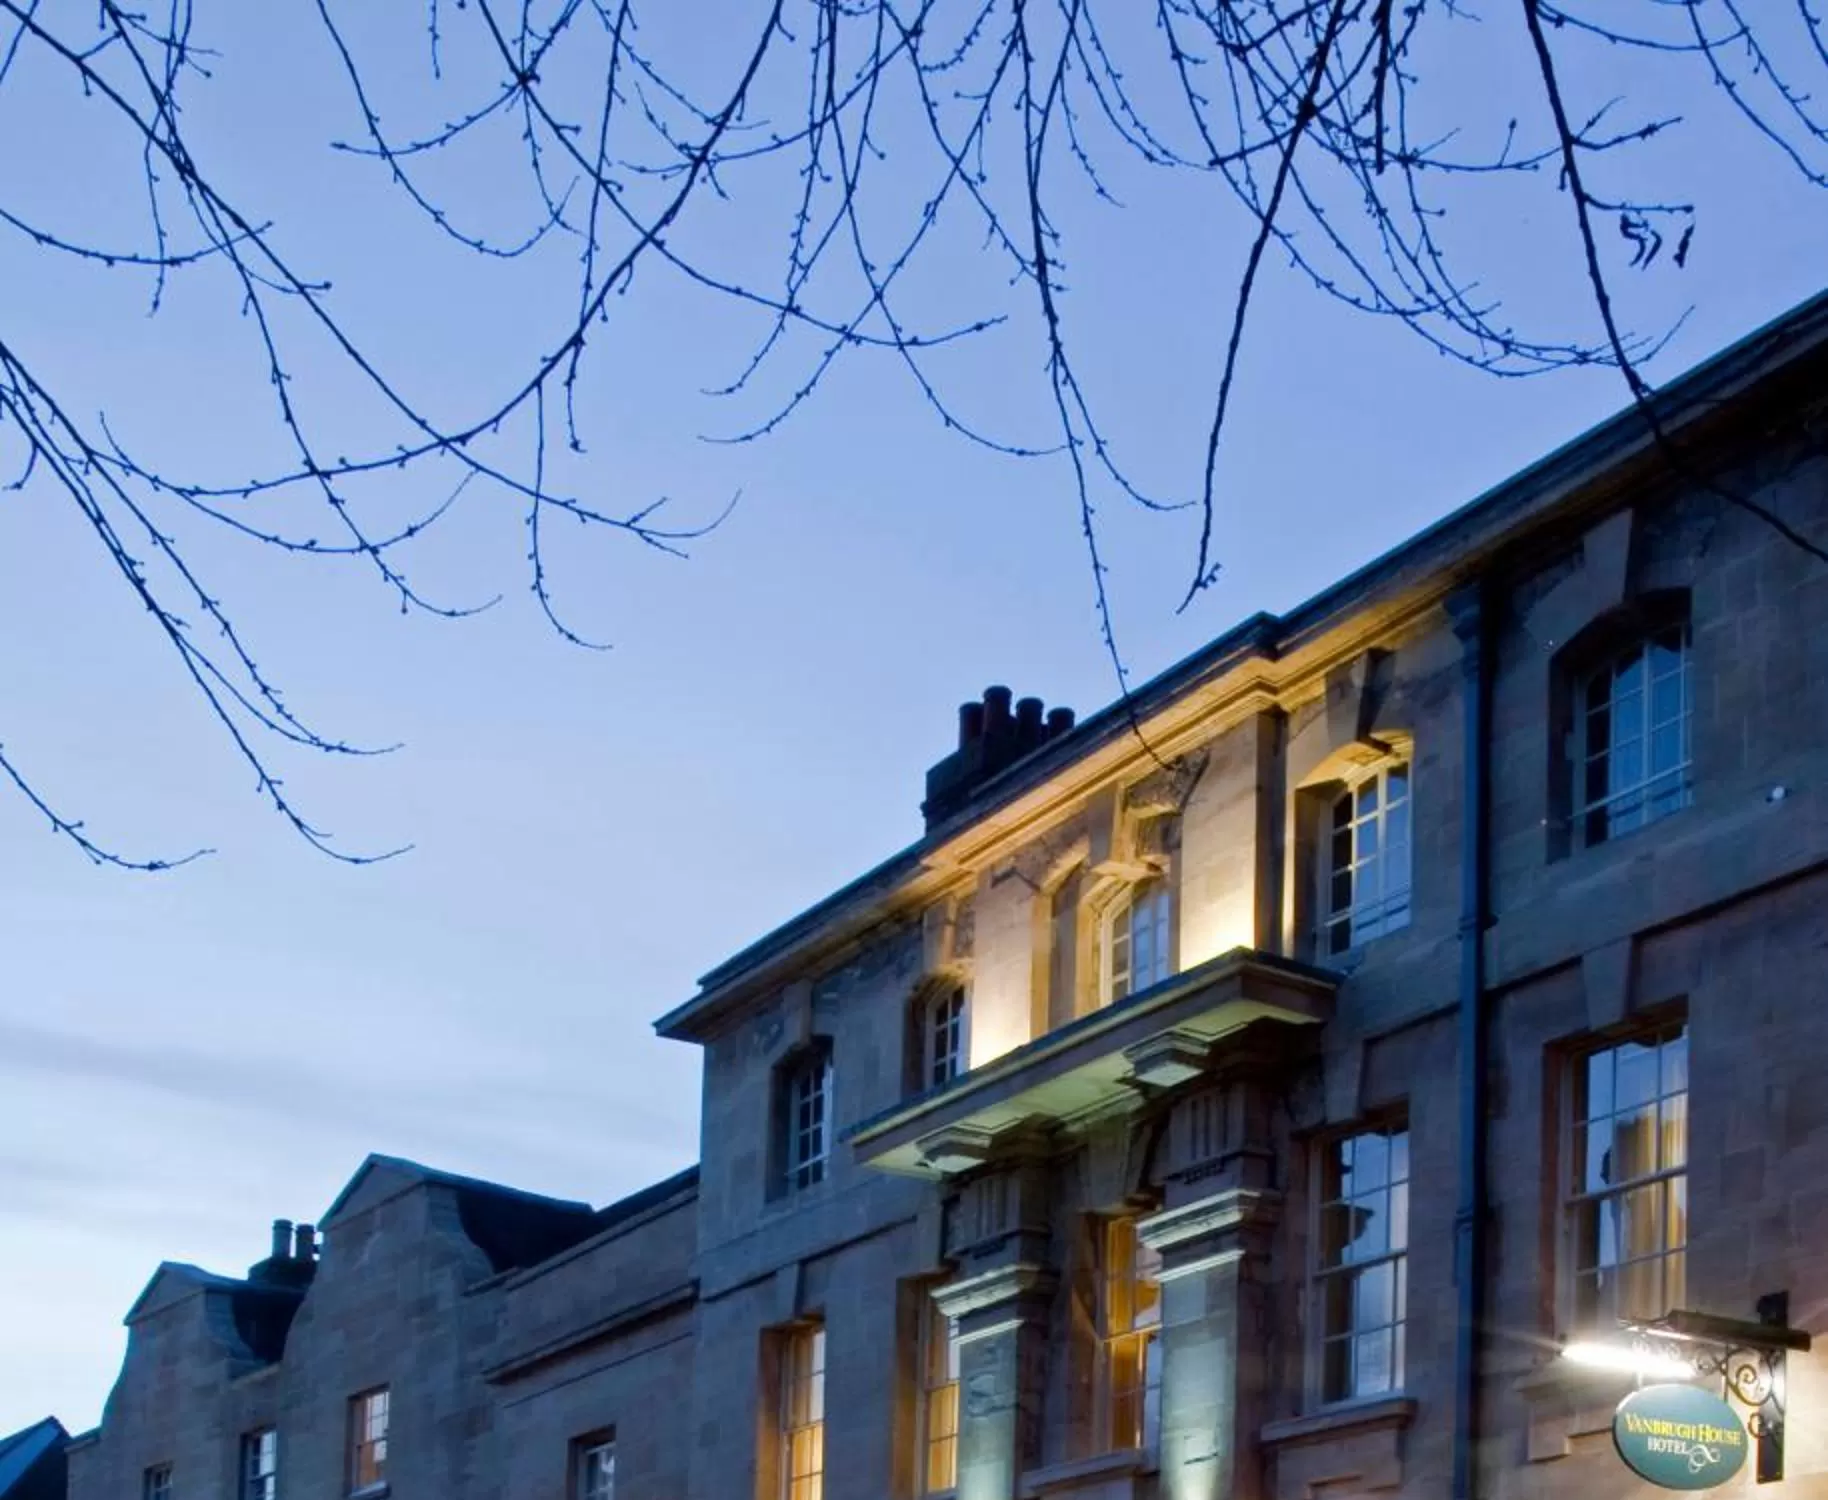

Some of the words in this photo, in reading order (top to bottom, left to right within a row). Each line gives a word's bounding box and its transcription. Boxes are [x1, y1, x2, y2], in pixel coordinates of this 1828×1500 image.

[1624, 1412, 1697, 1441] VANBRUGH
[1699, 1423, 1741, 1446] HOUSE
[1647, 1436, 1687, 1454] HOTEL
